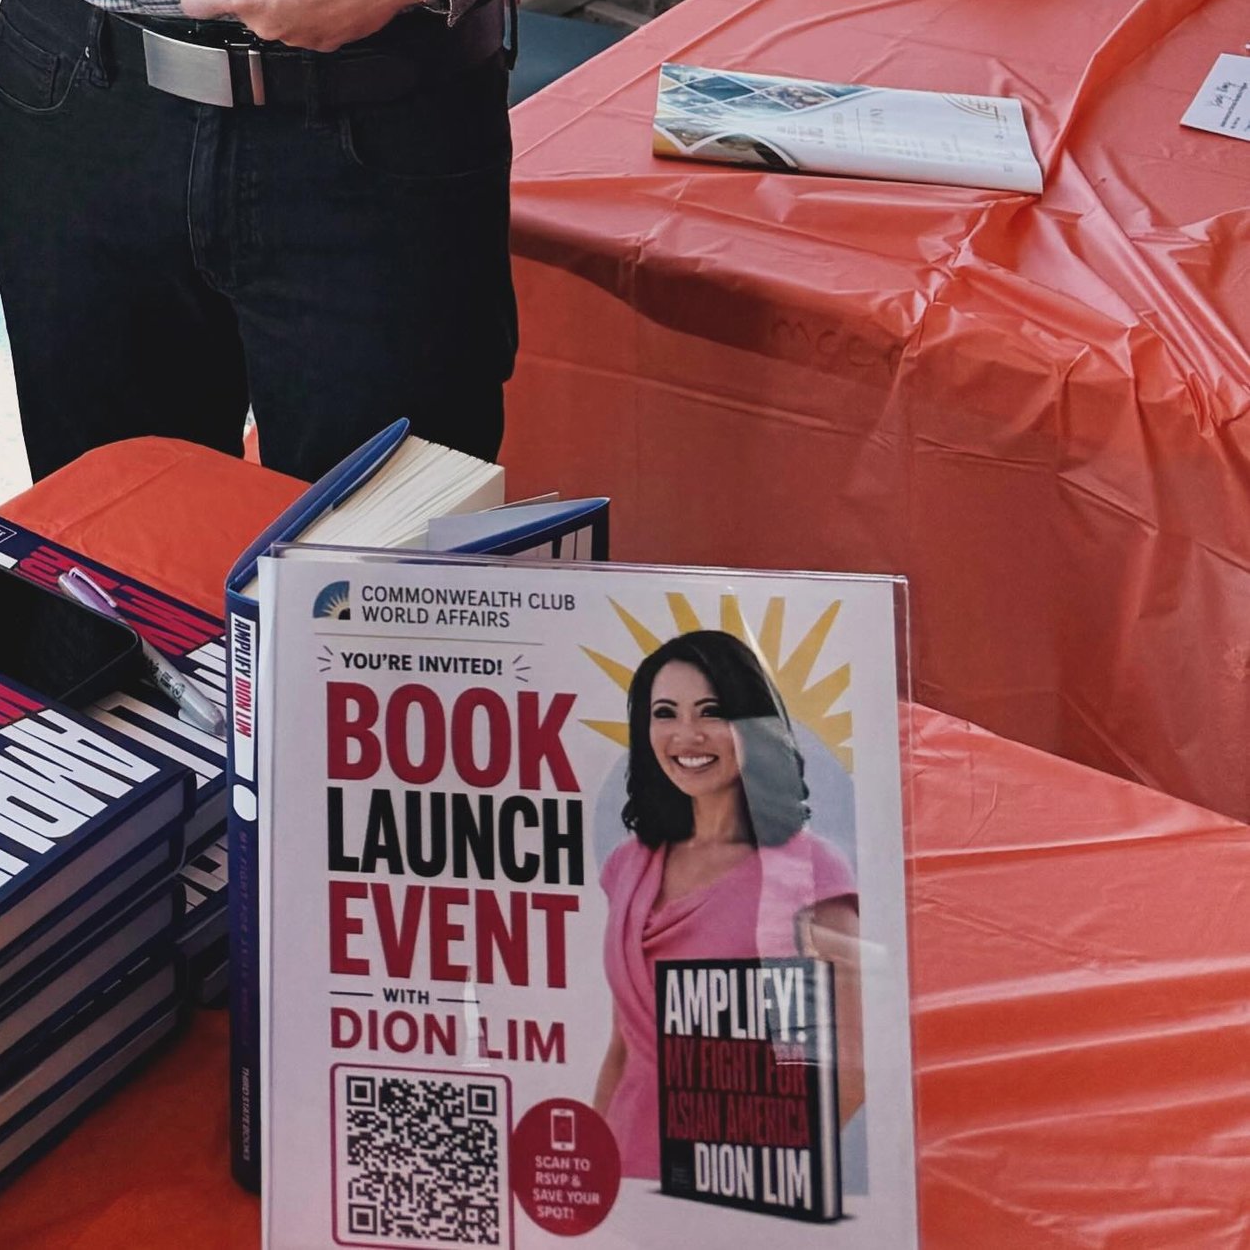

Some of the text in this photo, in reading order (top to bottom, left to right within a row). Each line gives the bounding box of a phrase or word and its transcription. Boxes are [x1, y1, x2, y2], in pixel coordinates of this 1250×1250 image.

[362, 585, 576, 611] COMMONWEALTH CLUB
[362, 606, 510, 628] WORLD AFFAIRS
[233, 618, 252, 738] AMPLIFY DION LIM
[340, 652, 503, 676] YOU'RE INVITED!
[326, 681, 581, 793] BOOK
[327, 786, 585, 886] LAUNCH
[328, 880, 580, 990] EVENT
[382, 987, 430, 1005] WITH
[664, 967, 808, 1043] AMPLIFY!
[330, 1006, 565, 1064] DION LIM
[664, 1036, 695, 1090] MY
[699, 1038, 758, 1091] FIGHT
[665, 1091, 810, 1147] ASIAN AMERICA
[535, 1154, 591, 1171] SCAN TO
[535, 1171, 581, 1187] RSVP &
[694, 1141, 755, 1201] DION
[762, 1146, 812, 1210] LIM
[532, 1188, 600, 1205] SAVE YOUR
[536, 1205, 575, 1220] SPOT!
